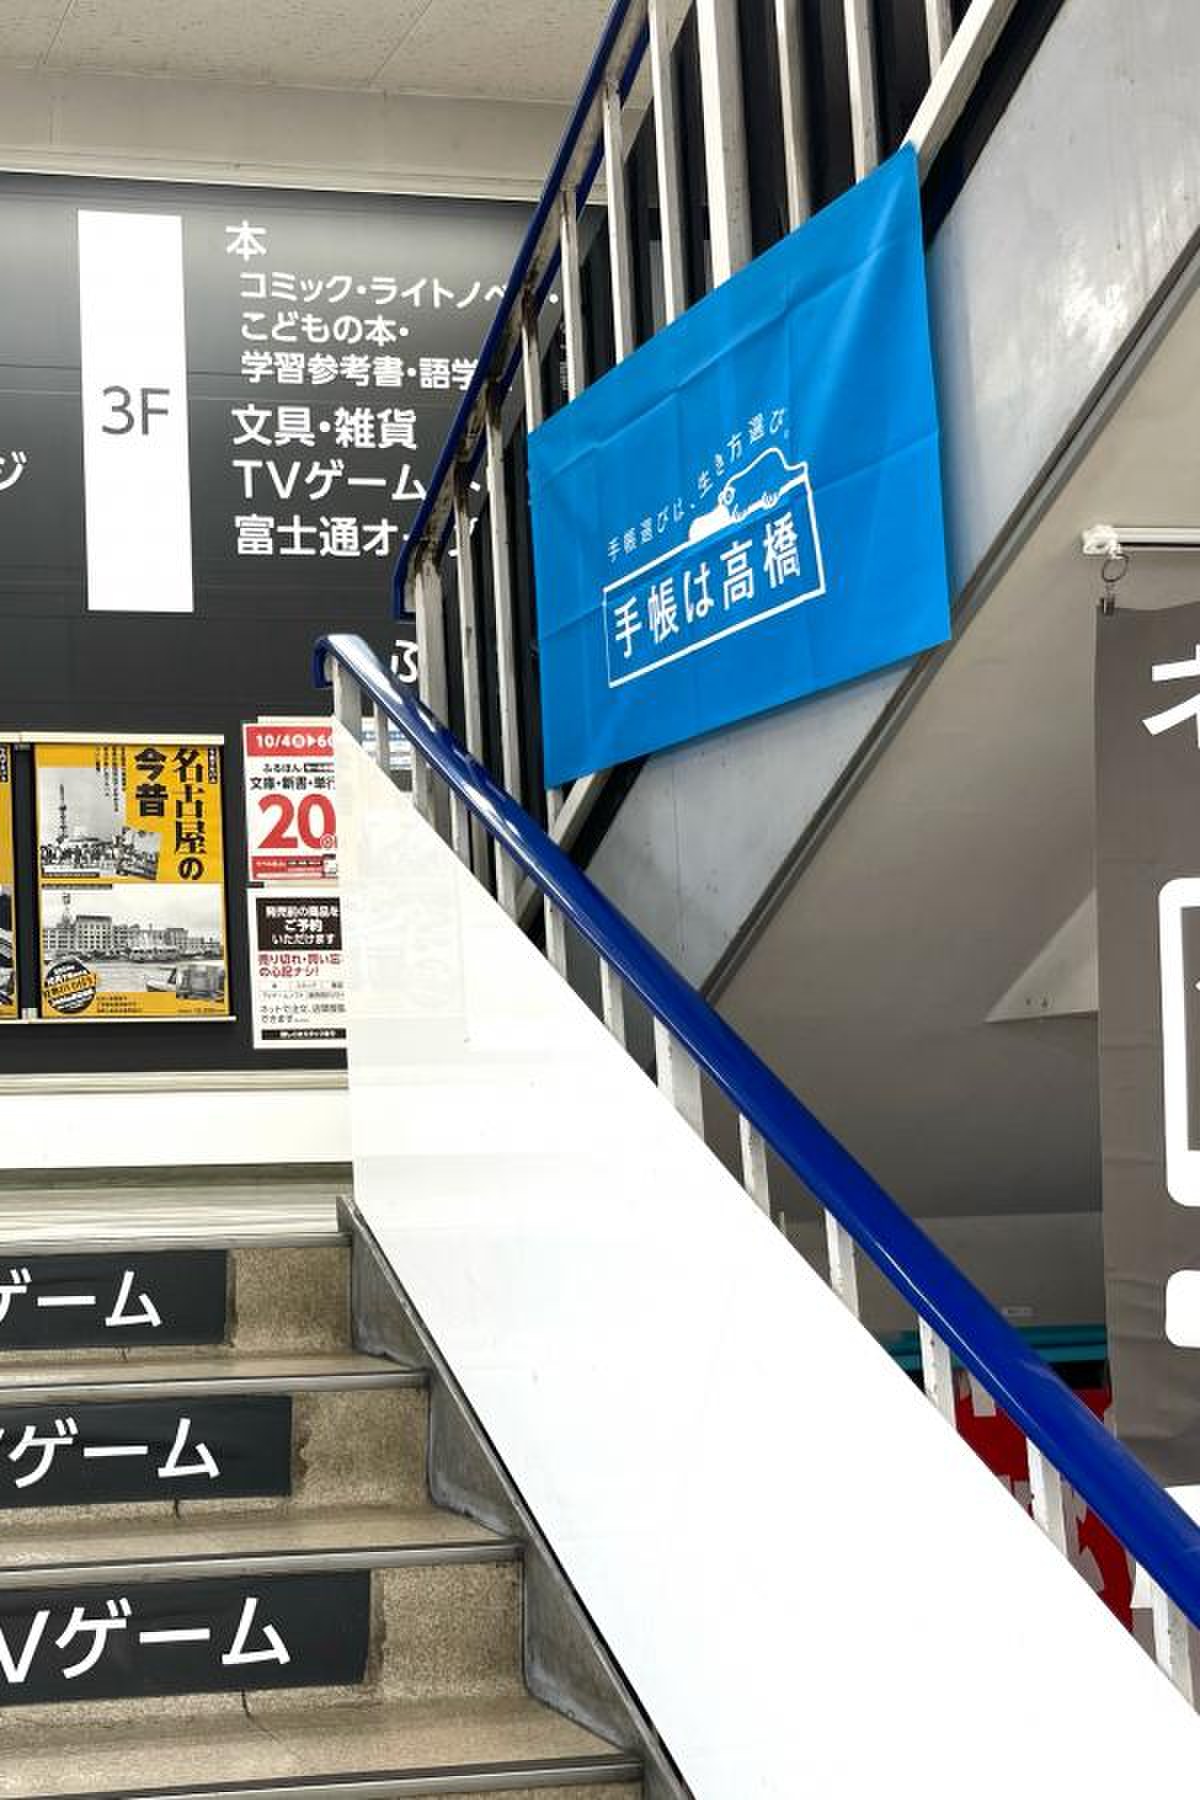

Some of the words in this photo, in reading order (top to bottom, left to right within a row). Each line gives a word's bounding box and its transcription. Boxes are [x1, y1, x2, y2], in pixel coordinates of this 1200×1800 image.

[226, 221, 266, 261] 本
[241, 313, 409, 346] こどもの本・
[102, 386, 170, 435] 3F
[232, 404, 417, 449] 文具・雑貨
[233, 460, 482, 500] TVゲーム
[614, 512, 801, 658] 手帳は高橋
[133, 747, 169, 817] 今昔
[173, 746, 206, 881] 名古屋の
